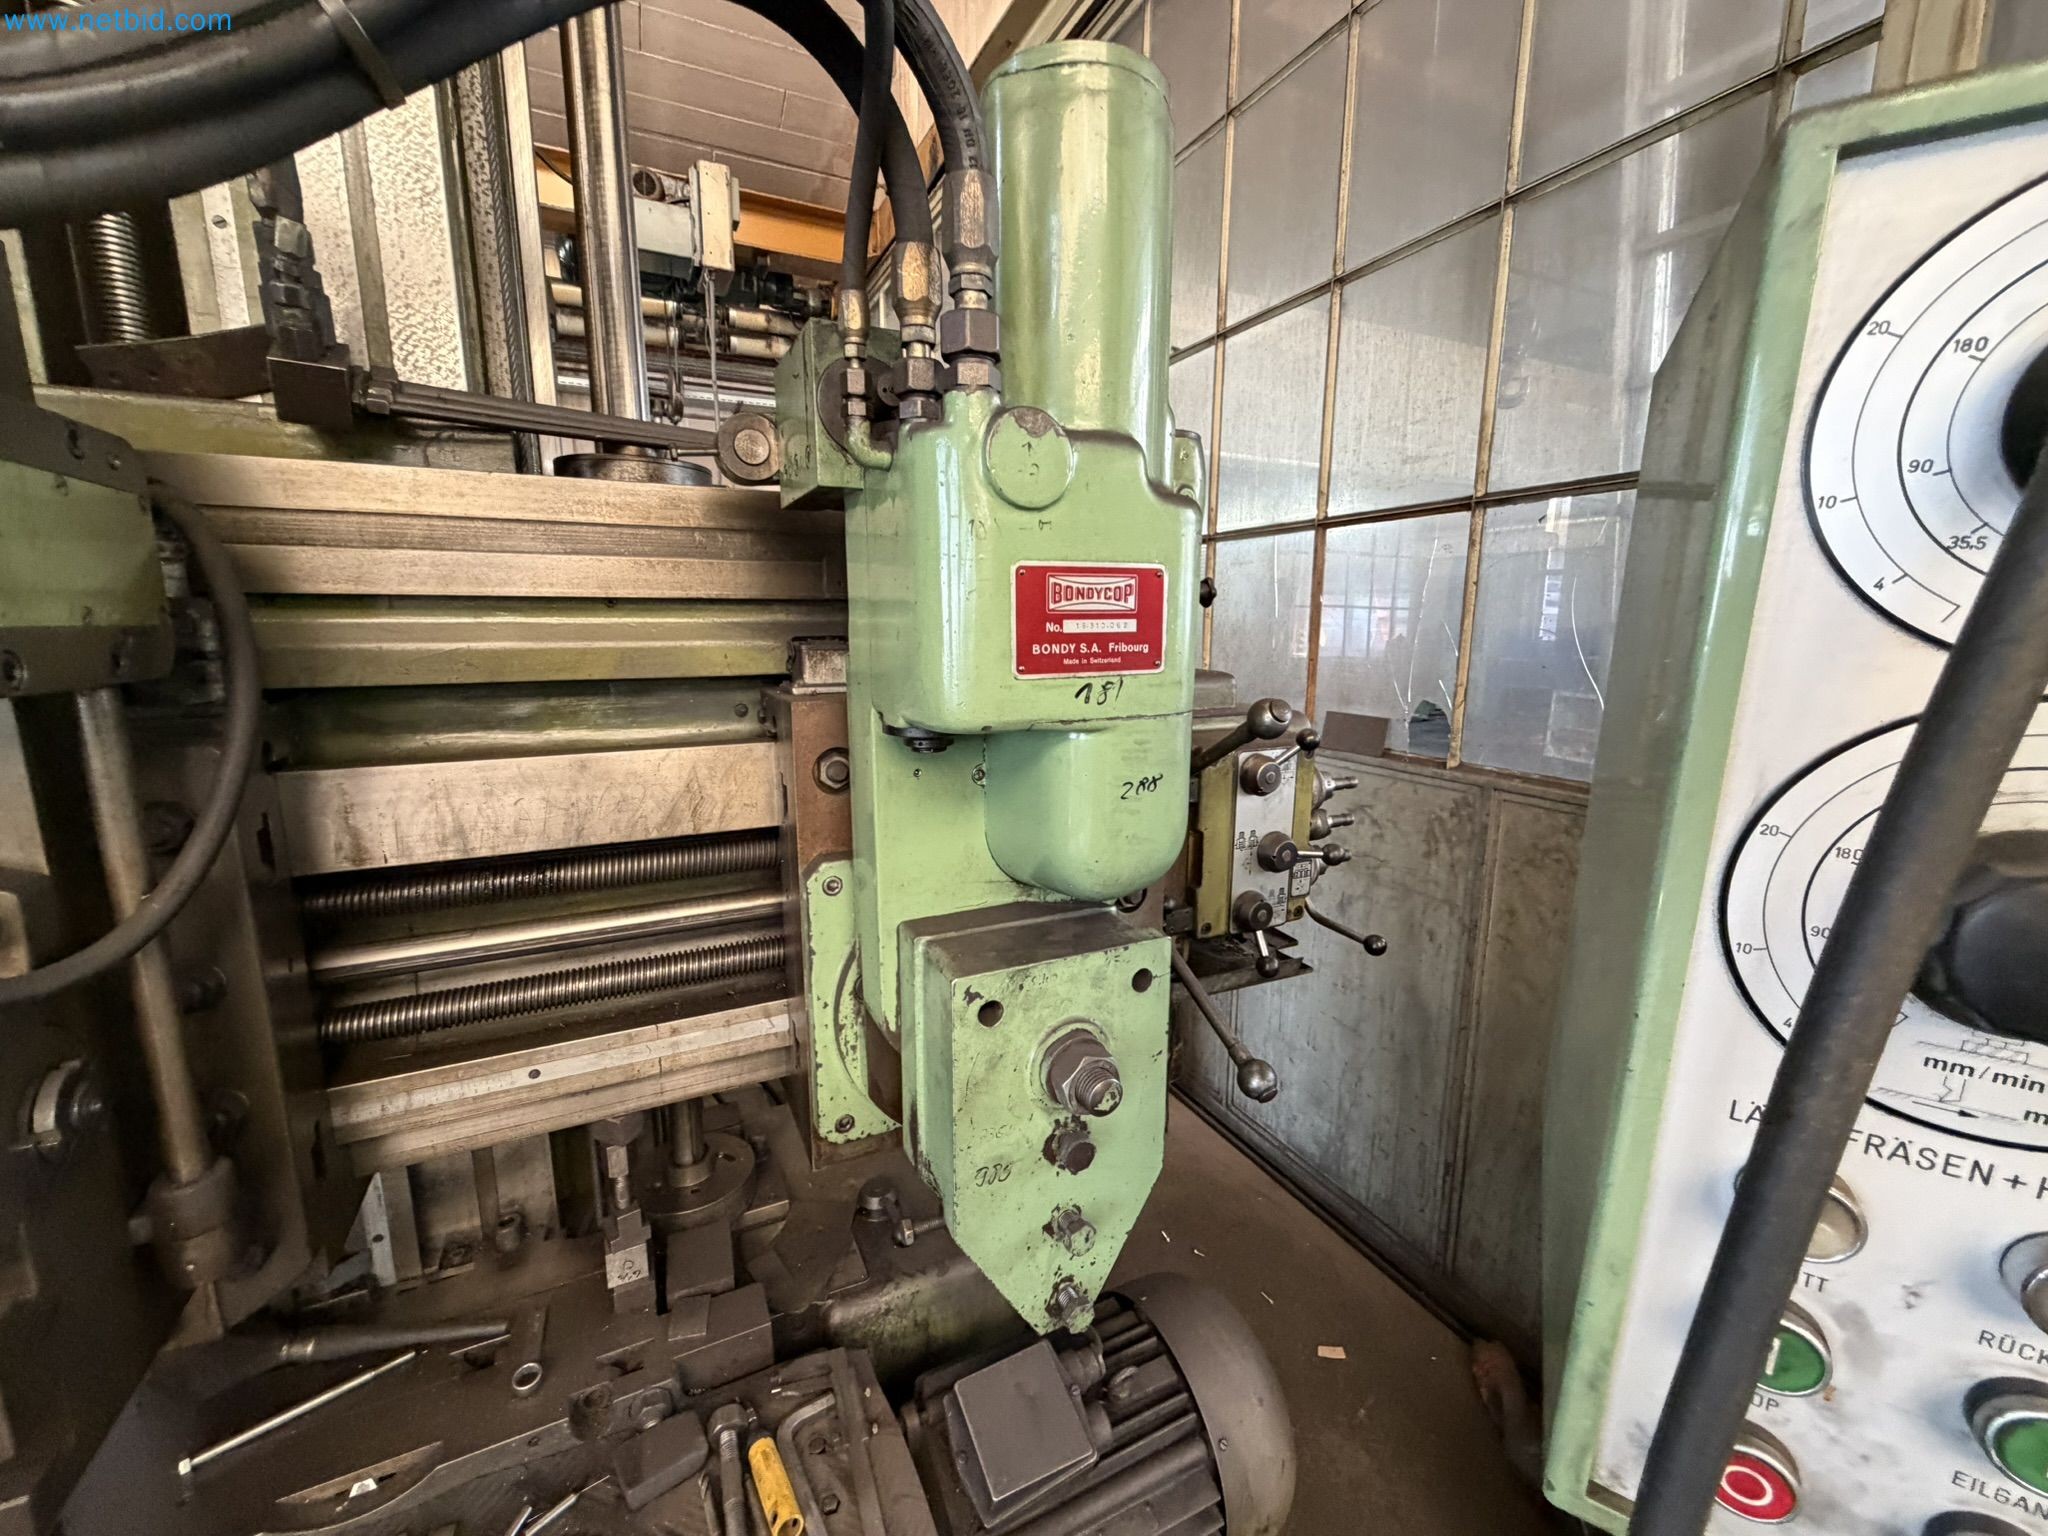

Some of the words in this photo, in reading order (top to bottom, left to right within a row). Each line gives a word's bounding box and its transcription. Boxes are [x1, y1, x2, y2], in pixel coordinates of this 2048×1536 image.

[1866, 319, 1890, 336] 20
[1952, 335, 1989, 353] 180
[1907, 458, 1934, 474] 90
[1817, 495, 1838, 510] 10
[1873, 576, 1886, 592] 4
[1051, 581, 1134, 605] BONDYCOP
[1045, 621, 1063, 633] No.
[1032, 643, 1076, 655] BONDY
[1079, 642, 1102, 654] S.A.
[1108, 641, 1149, 654] Fribourg
[1063, 657, 1080, 665] Made
[1081, 656, 1088, 664] in
[1089, 656, 1121, 664] Switzerland
[1760, 823, 1780, 837] 20
[1735, 942, 1753, 955] 10
[1923, 1056, 2046, 1094] mm/min
